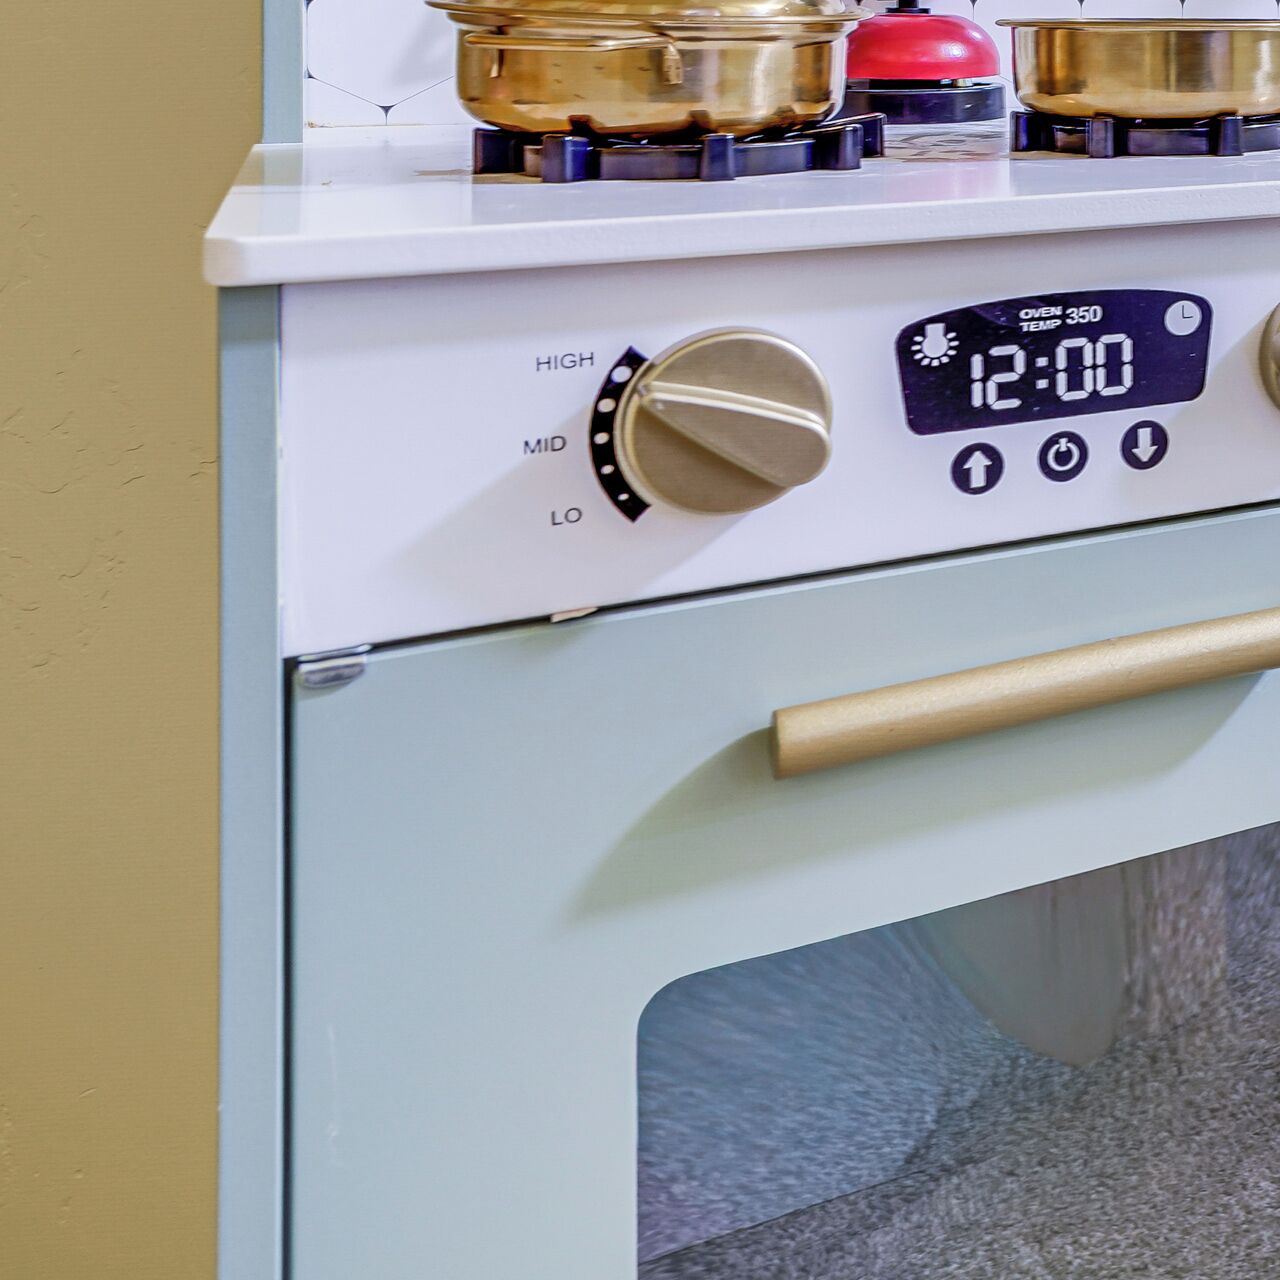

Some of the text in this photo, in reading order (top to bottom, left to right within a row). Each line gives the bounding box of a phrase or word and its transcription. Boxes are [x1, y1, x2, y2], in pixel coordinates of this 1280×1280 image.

[1019, 306, 1063, 319] OVEN
[1065, 305, 1103, 324] 350
[1019, 319, 1062, 332] TEMP
[536, 352, 595, 371] HIGH
[970, 333, 1133, 410] 12:00
[523, 436, 567, 455] MID
[551, 508, 583, 526] LO
